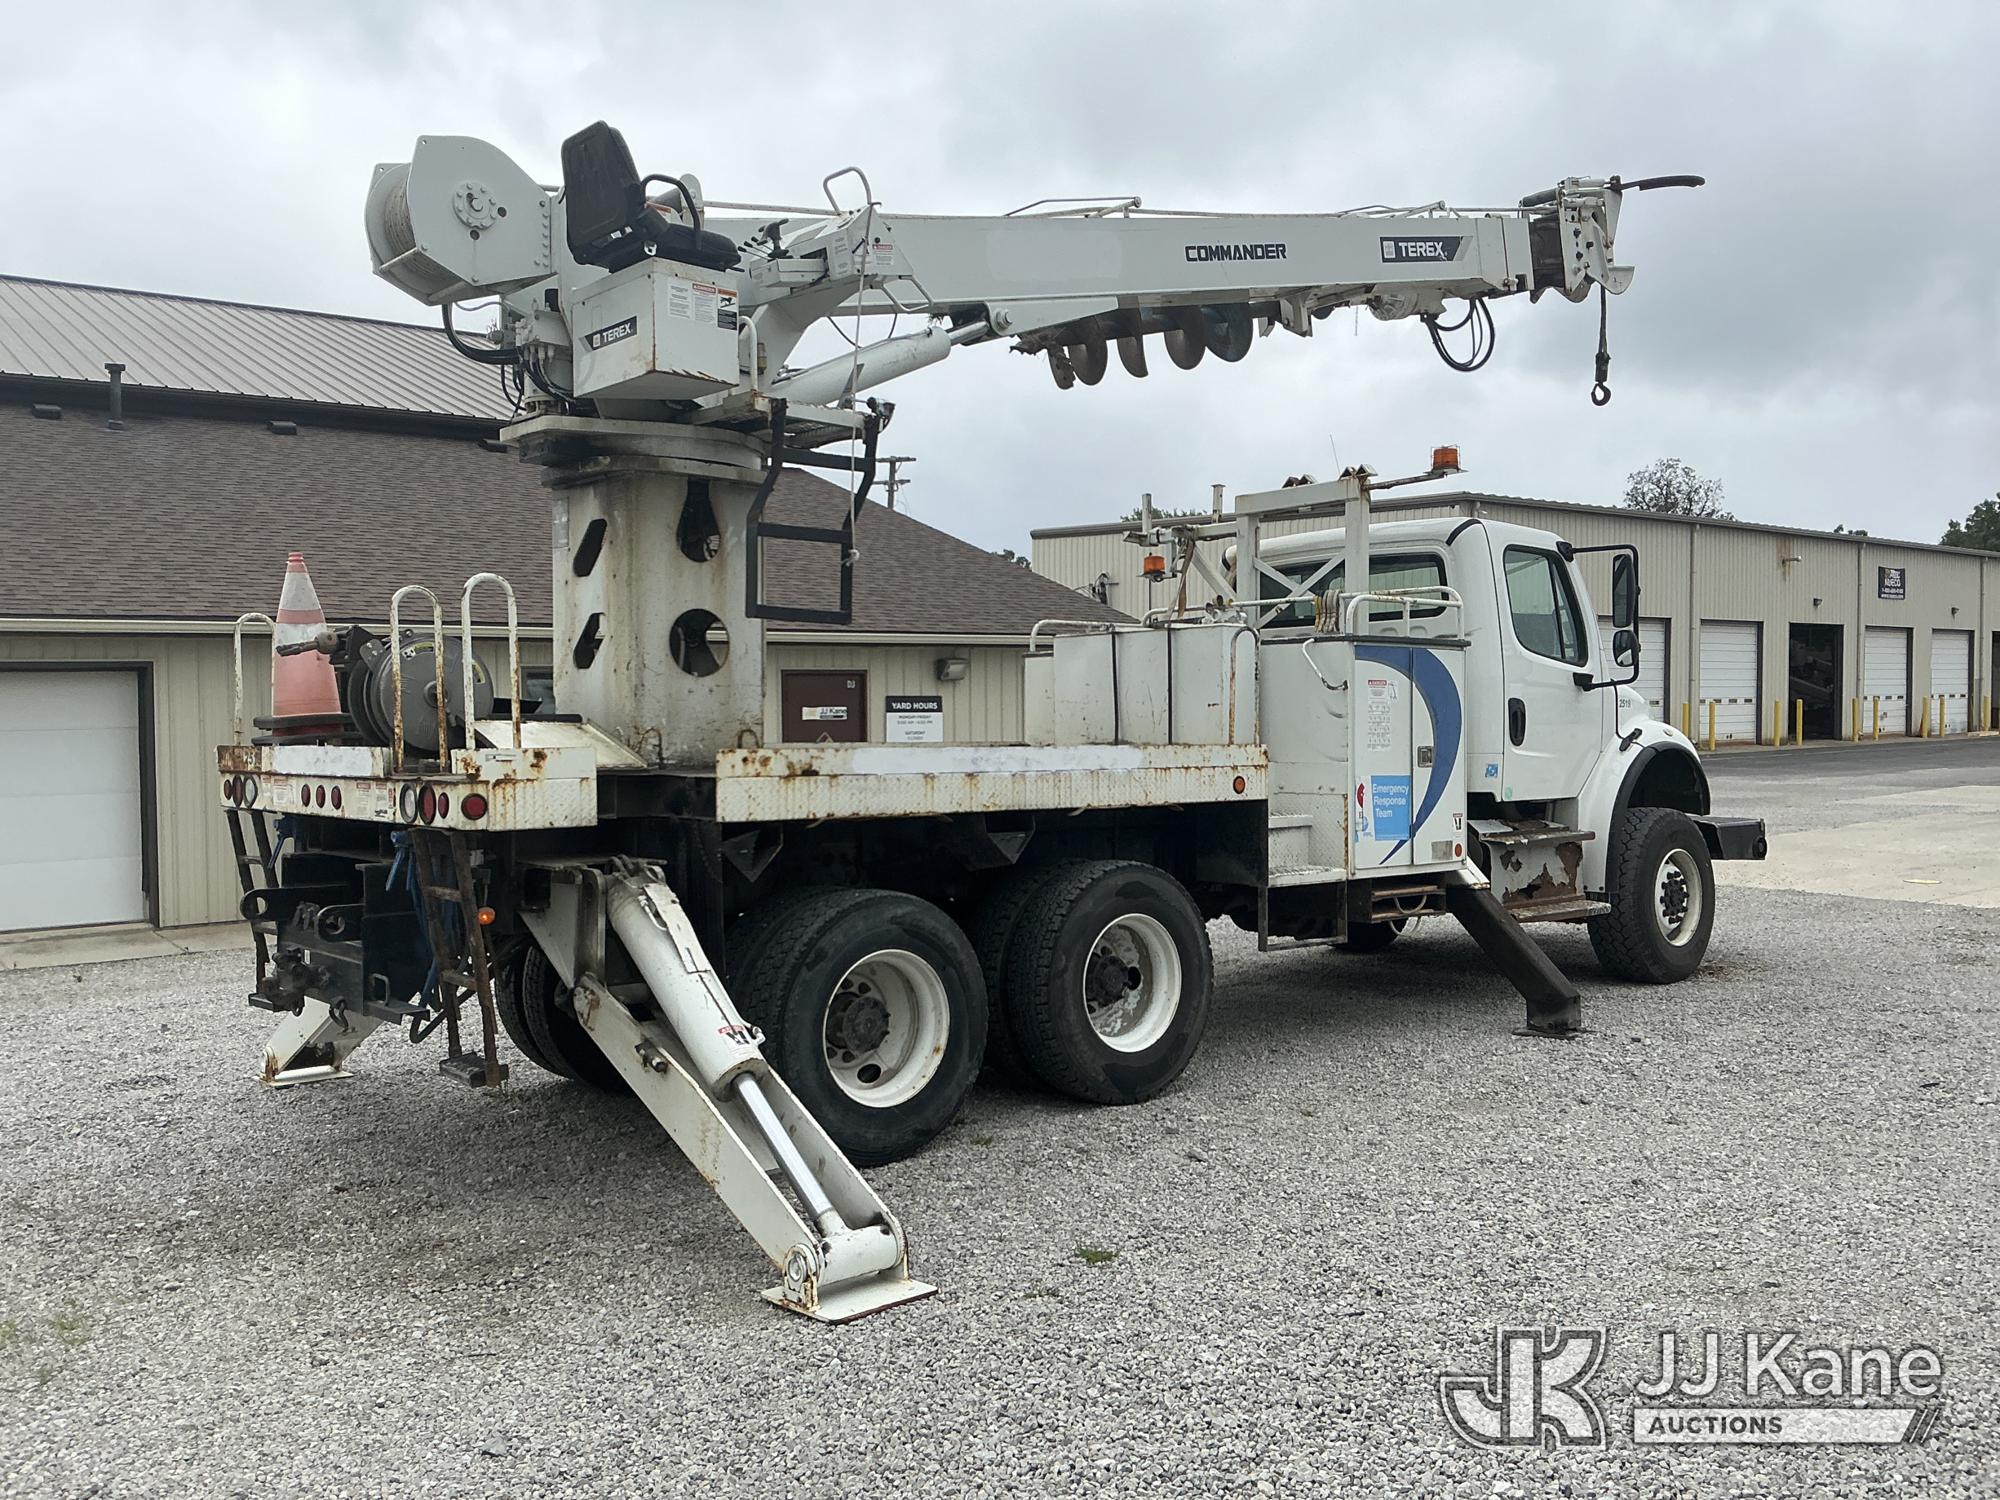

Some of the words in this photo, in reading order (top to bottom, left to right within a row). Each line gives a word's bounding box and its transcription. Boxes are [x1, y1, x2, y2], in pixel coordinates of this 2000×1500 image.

[1184, 243, 1287, 262] COMMANDER
[1398, 241, 1444, 257] TEREX
[602, 322, 631, 343] TEREX
[891, 702, 912, 710] YARD
[913, 702, 938, 710] HOURS
[1372, 783, 1409, 796] Emergency
[1373, 796, 1407, 807] Response
[1375, 808, 1393, 817] Team
